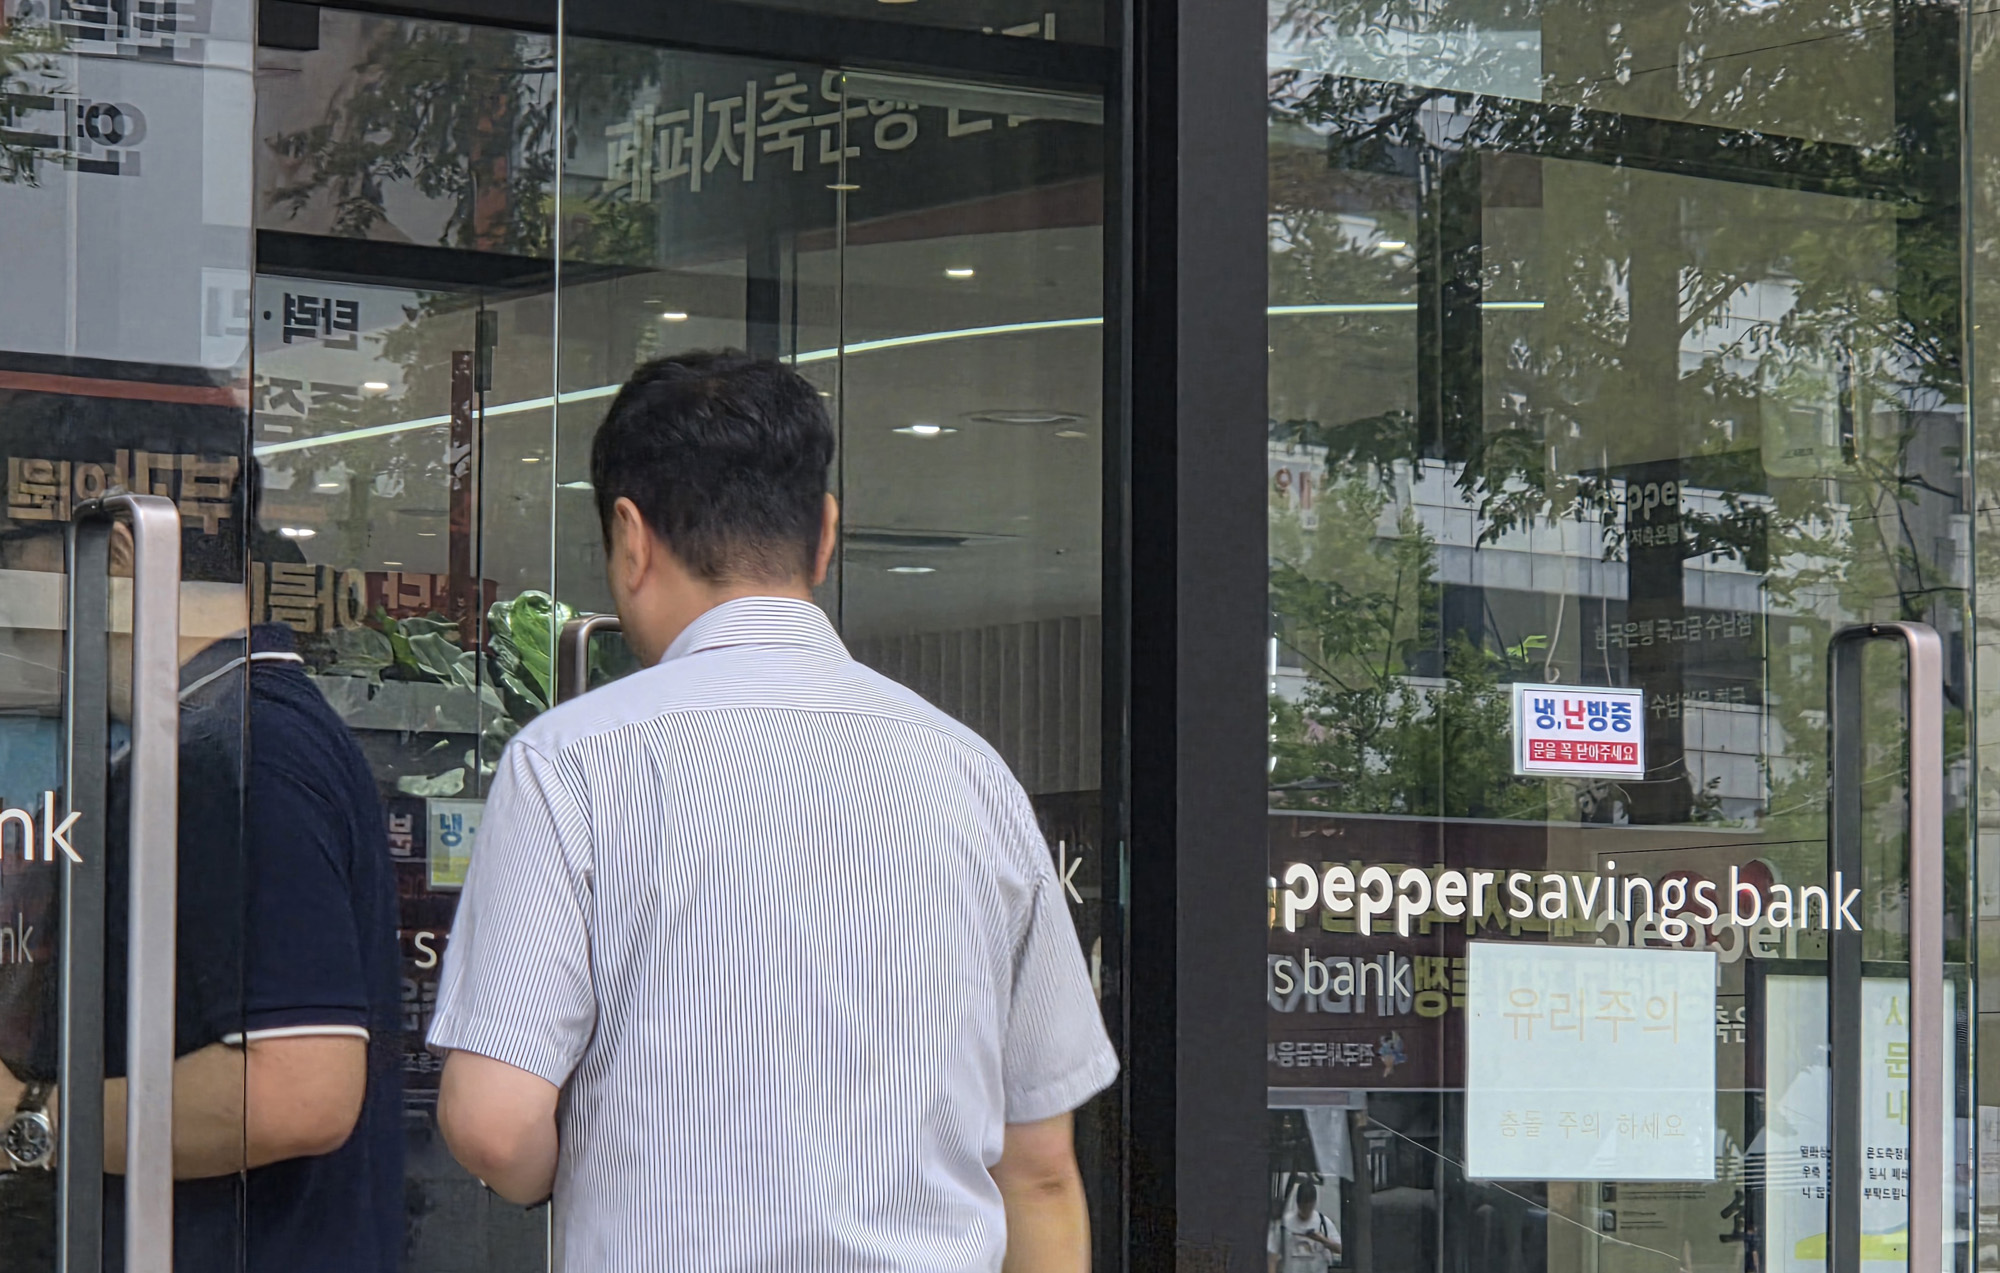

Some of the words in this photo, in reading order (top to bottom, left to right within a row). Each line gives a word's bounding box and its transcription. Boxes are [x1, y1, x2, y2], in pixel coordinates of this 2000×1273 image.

[604, 67, 918, 203] 페퍼저축은행
[1626, 523, 1680, 548] 저축은행
[1594, 620, 1654, 650] 한국은행
[1657, 615, 1703, 643] 국고금
[1534, 698, 1633, 733] 냉,난방중
[1534, 741, 1557, 760] 문을
[1561, 742, 1574, 760] 꼭
[1576, 743, 1634, 762] 닫아주세요
[1284, 862, 1493, 937] pepper
[1508, 861, 1719, 942] savings
[1729, 866, 1862, 931] bank
[1304, 948, 1411, 1000] bank
[1503, 987, 1679, 1045] 유리주의
[1557, 1110, 1601, 1140] 주의
[1616, 1110, 1686, 1140] 하세요
